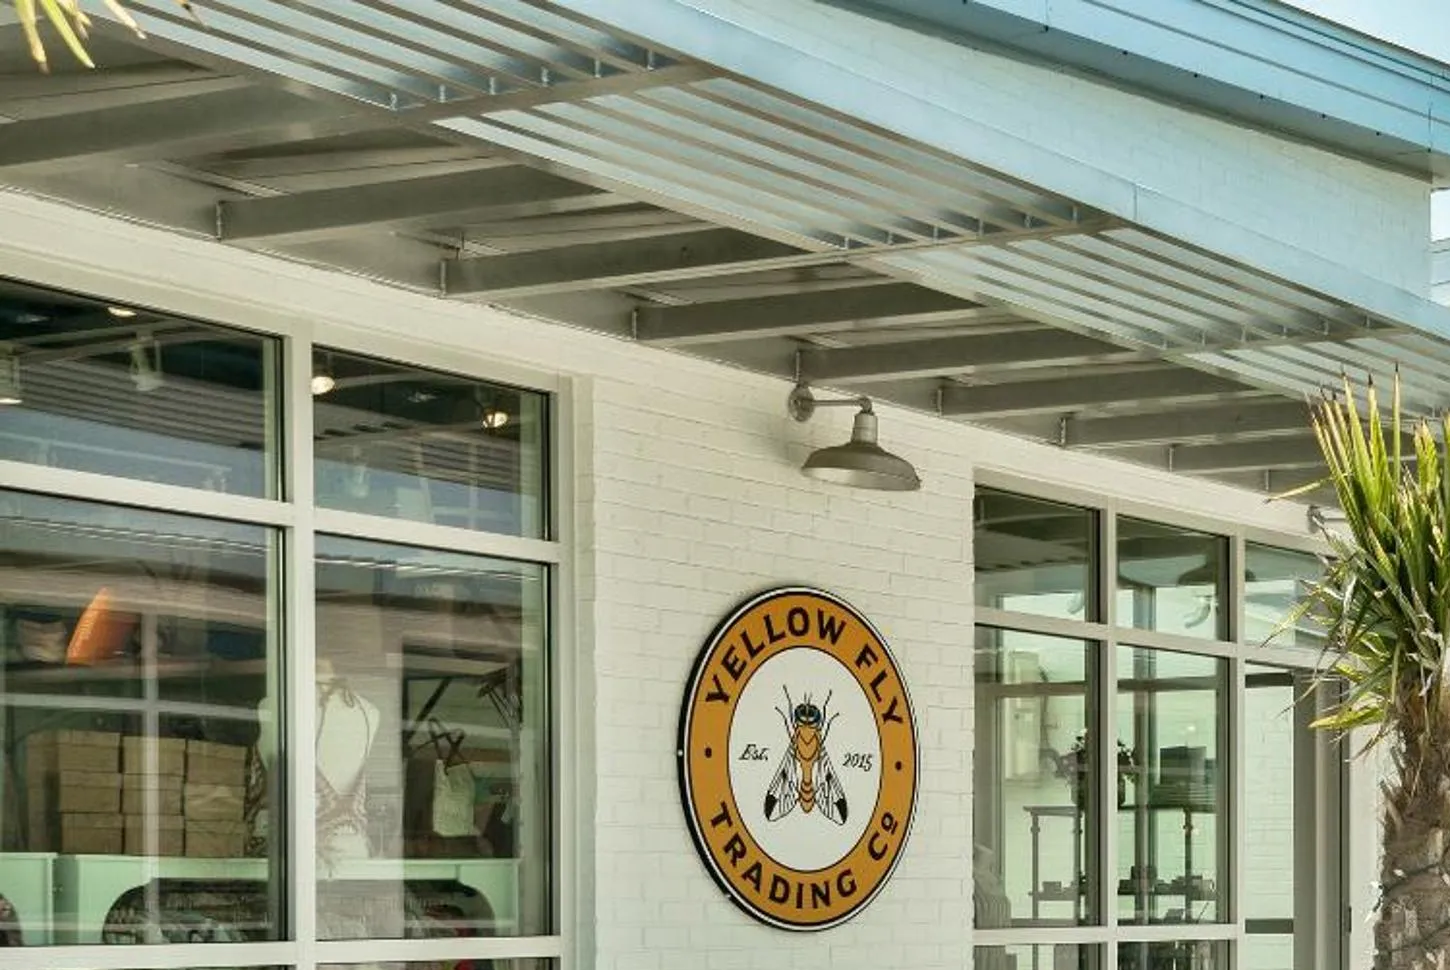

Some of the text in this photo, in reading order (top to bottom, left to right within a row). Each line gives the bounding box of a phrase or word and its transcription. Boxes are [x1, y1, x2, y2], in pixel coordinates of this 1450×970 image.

[705, 607, 904, 725] YELLOW FLY
[842, 752, 873, 772] 2015
[708, 802, 857, 909] TRADING
